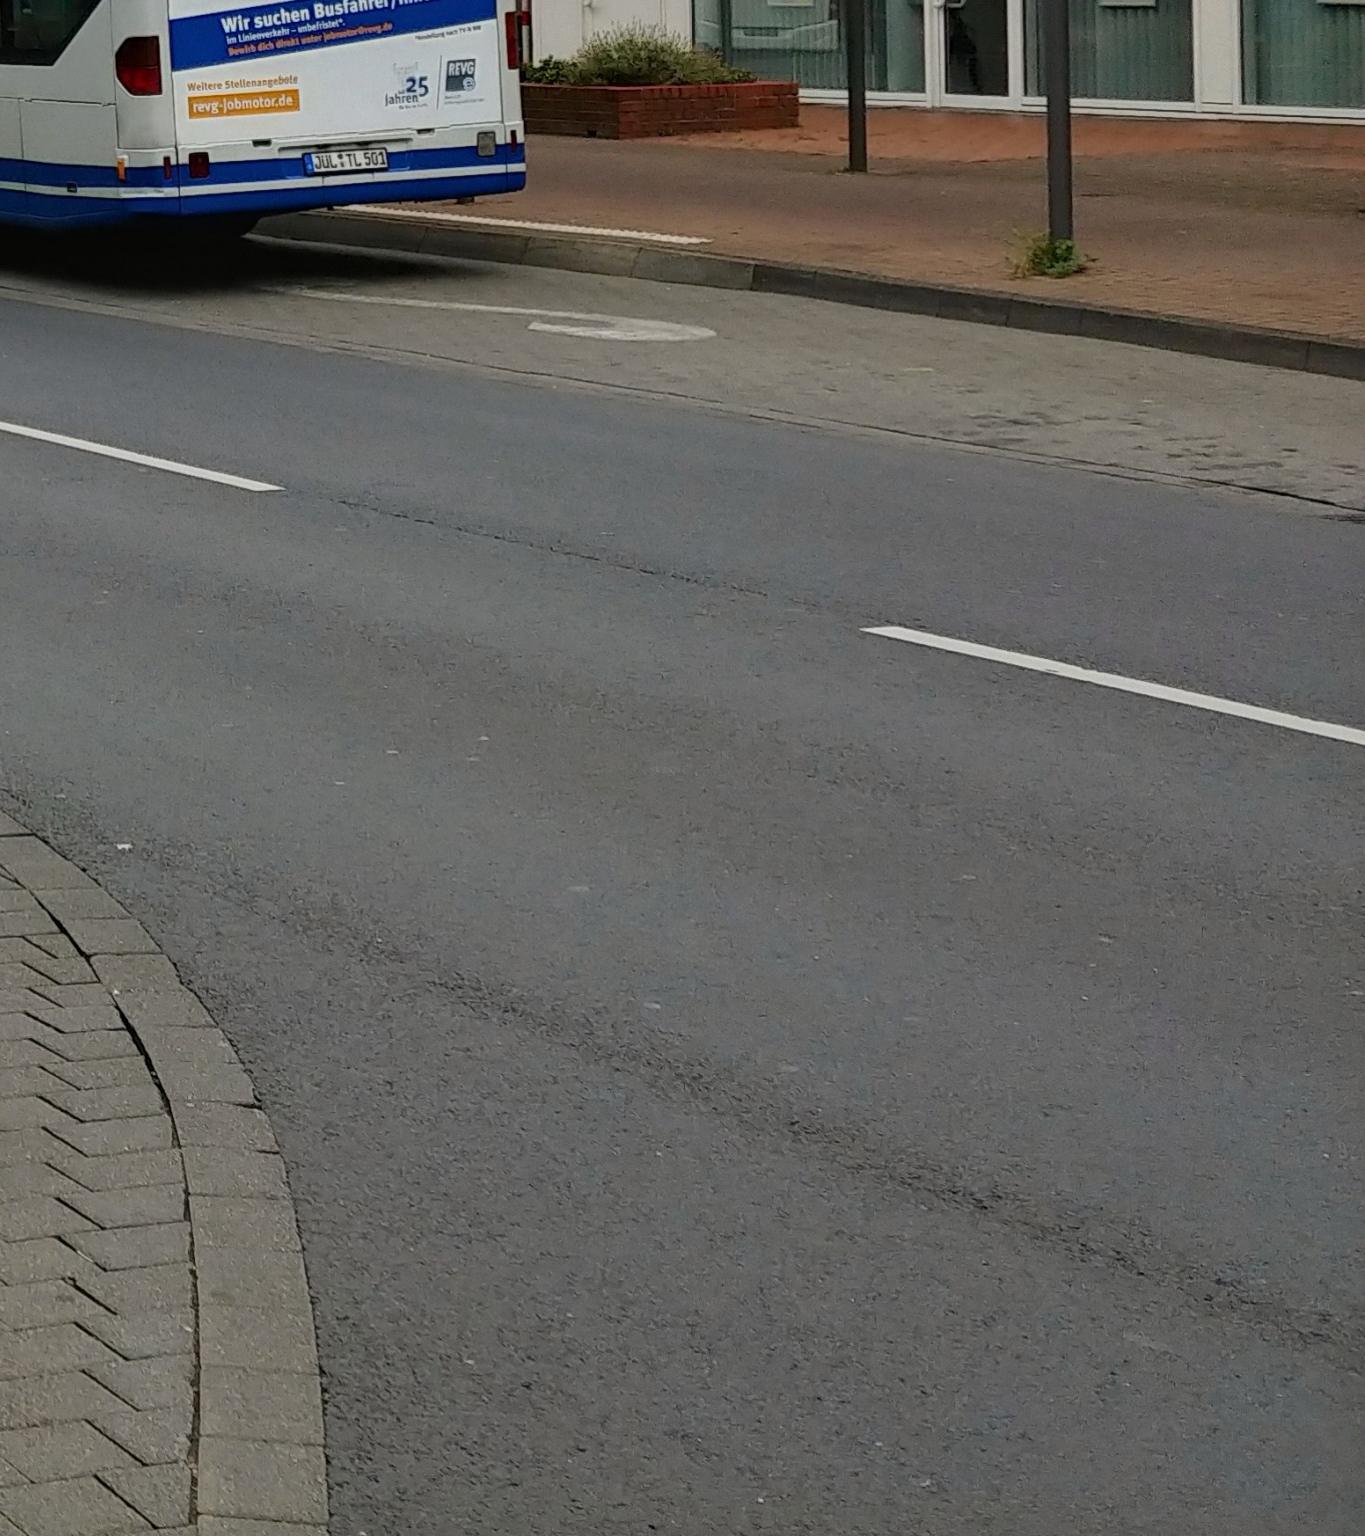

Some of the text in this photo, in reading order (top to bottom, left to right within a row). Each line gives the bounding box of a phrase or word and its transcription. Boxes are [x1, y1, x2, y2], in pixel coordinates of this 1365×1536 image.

[221, 15, 251, 33] Wir
[254, 8, 311, 29] suchen
[448, 61, 475, 76] REVG
[187, 79, 224, 92] Weitere
[405, 75, 429, 97] 25
[363, 151, 386, 166] 501
